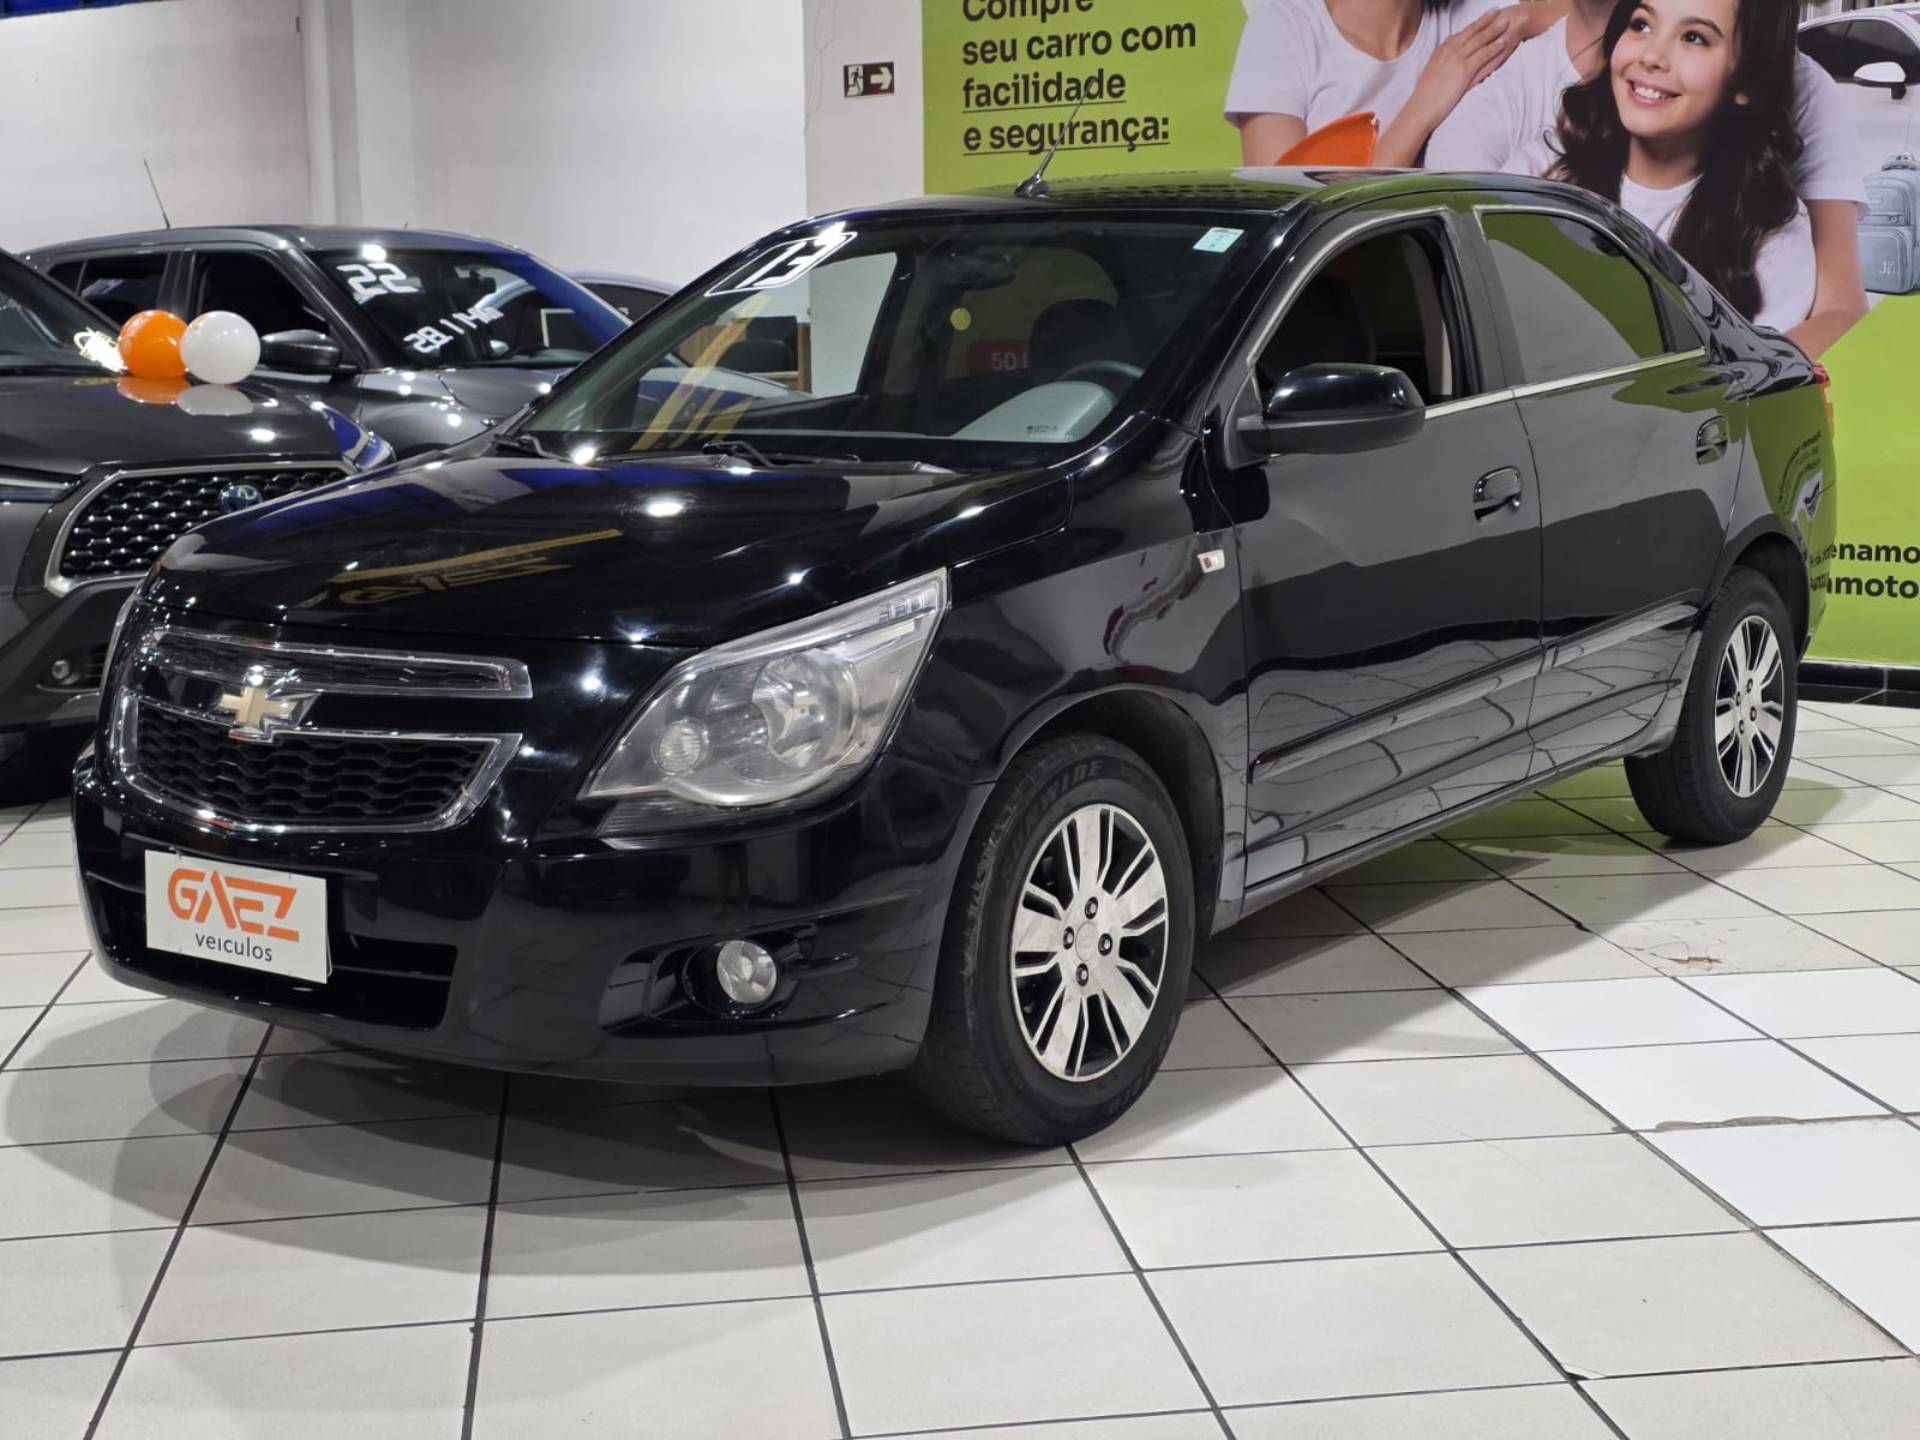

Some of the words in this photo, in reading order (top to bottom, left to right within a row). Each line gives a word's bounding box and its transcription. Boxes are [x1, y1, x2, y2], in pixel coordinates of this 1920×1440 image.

[962, 38, 1017, 65] seu
[1027, 30, 1112, 60] carro
[1121, 21, 1196, 53] com
[963, 68, 1126, 108] facilidade
[963, 126, 981, 151] e
[989, 116, 1169, 155] segurança:
[336, 262, 419, 294] 22
